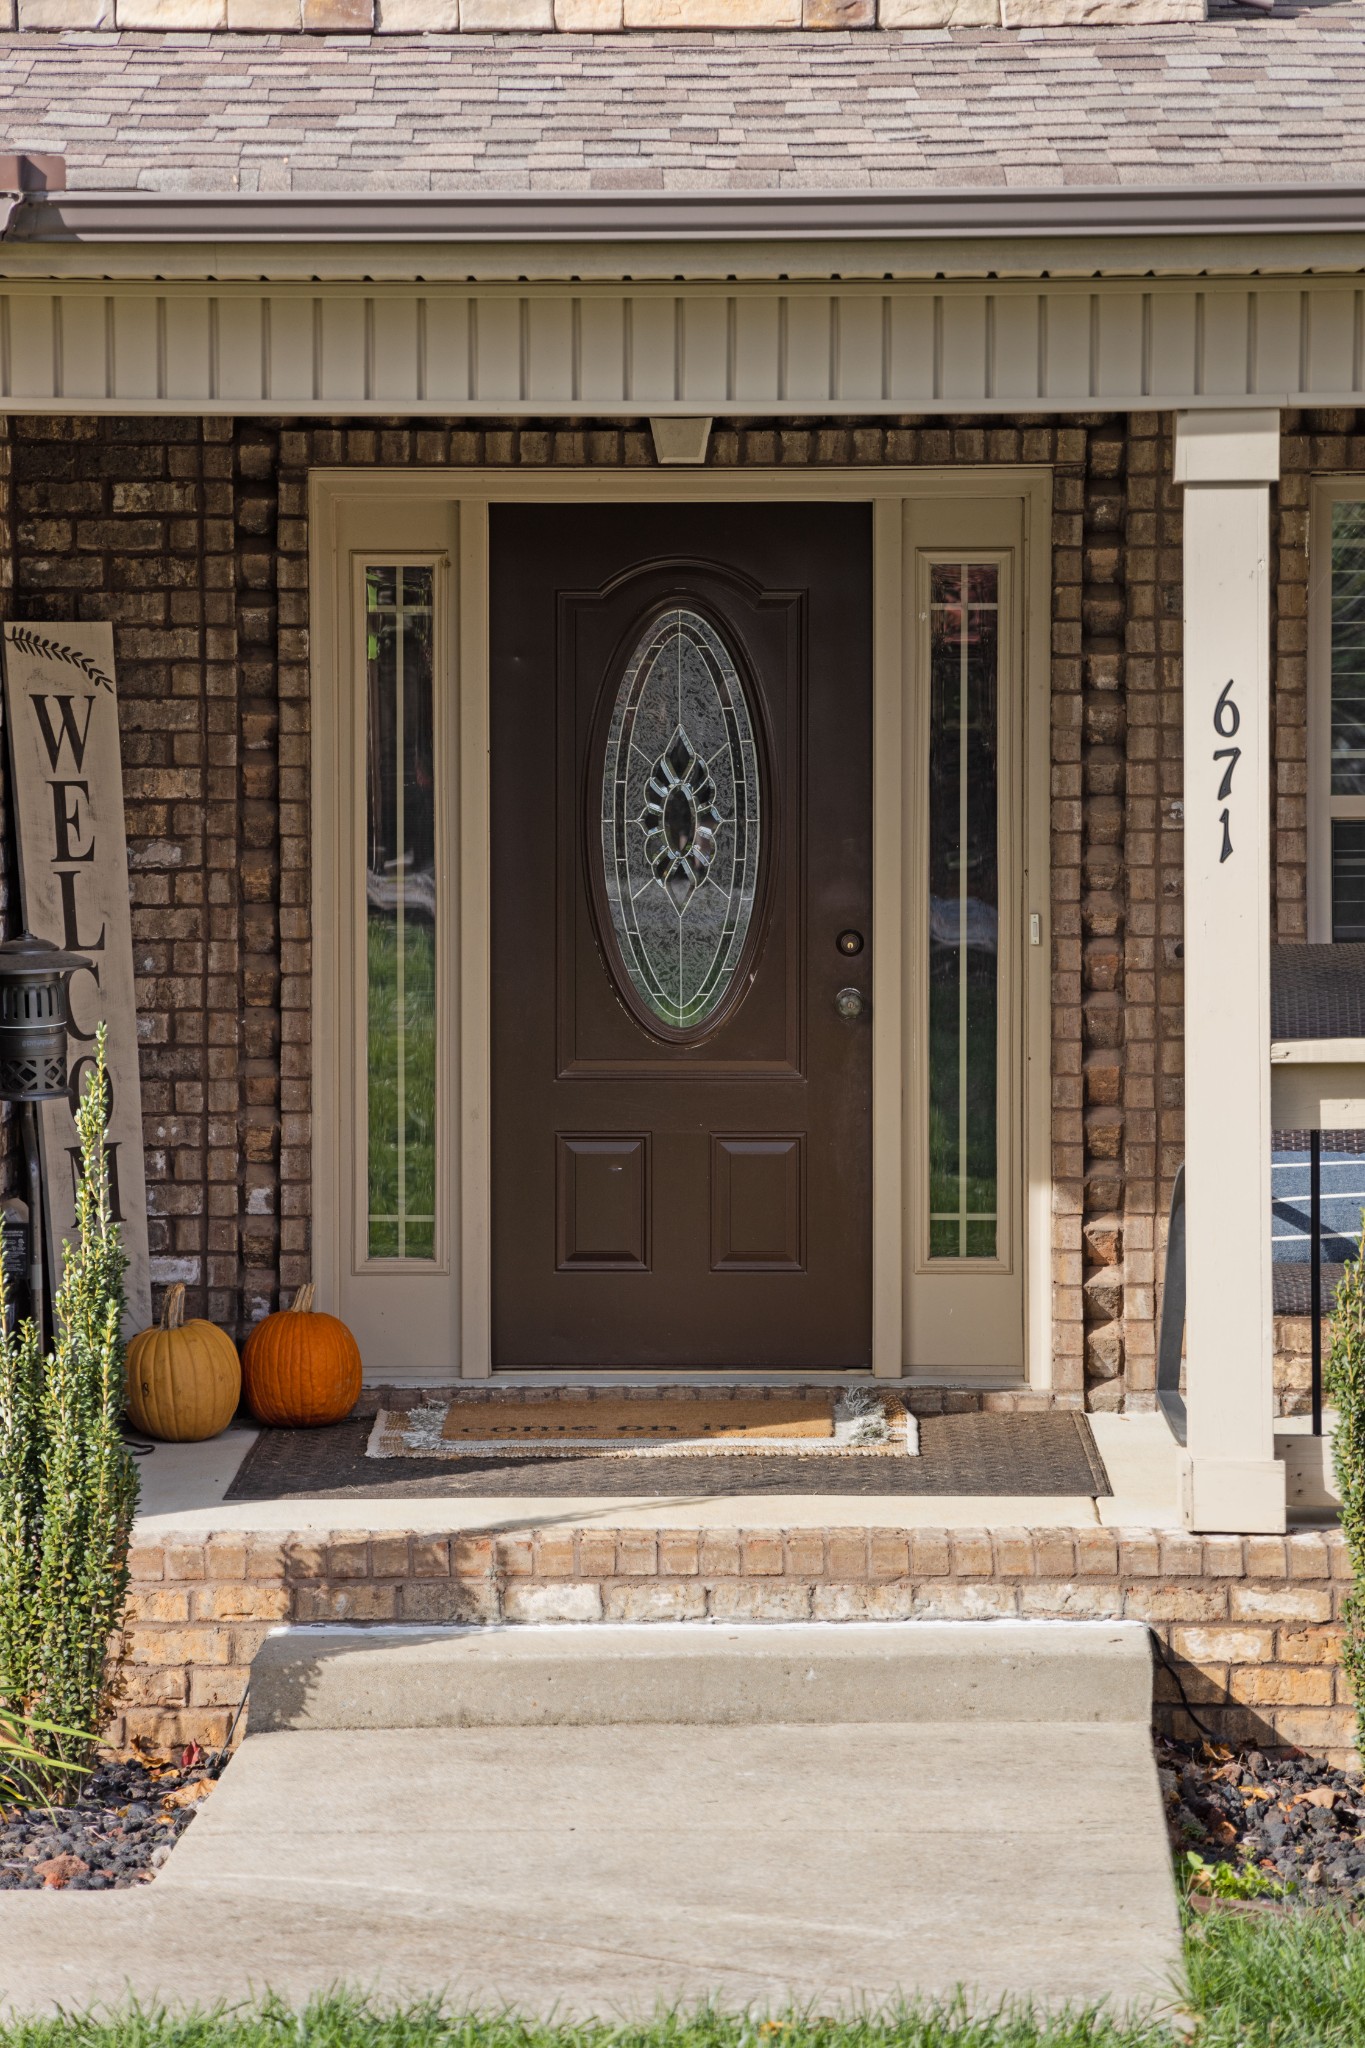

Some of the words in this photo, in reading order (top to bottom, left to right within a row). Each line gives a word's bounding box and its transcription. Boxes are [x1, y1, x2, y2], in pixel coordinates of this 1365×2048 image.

[1212, 678, 1242, 864] 671
[28, 693, 127, 1246] WELCOM
[461, 1424, 598, 1433] come
[617, 1424, 677, 1432] on
[703, 1422, 747, 1432] in
